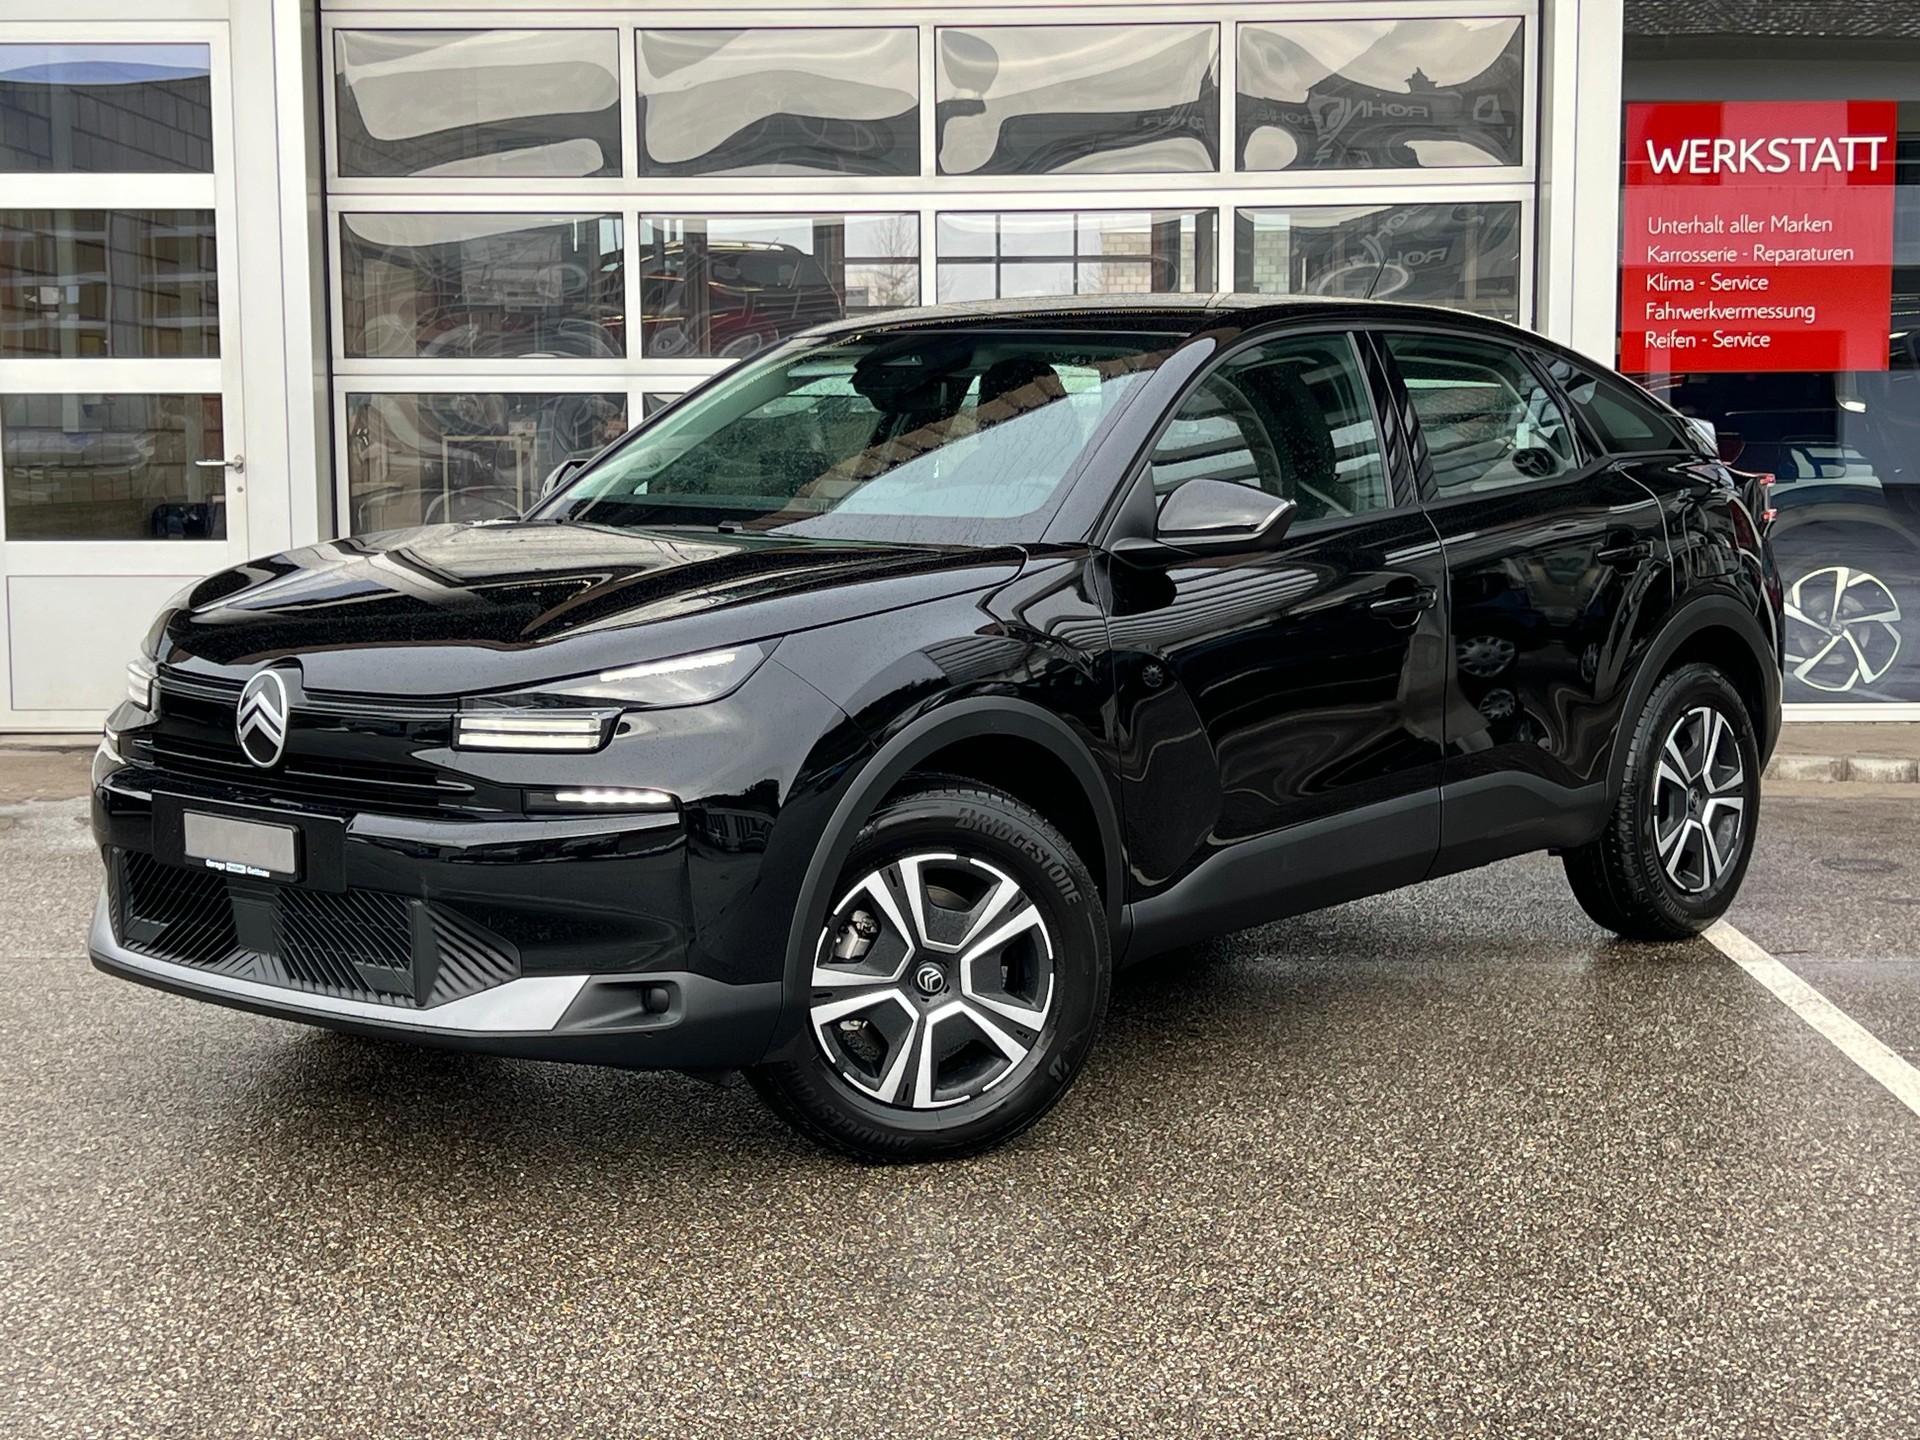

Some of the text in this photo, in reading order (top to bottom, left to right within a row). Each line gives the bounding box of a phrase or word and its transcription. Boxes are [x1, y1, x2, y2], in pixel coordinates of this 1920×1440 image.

[1646, 136, 1888, 175] WERKSTATT
[1648, 213, 1833, 235] Unterhalt aller Marken
[1647, 245, 1738, 263] Karrosserie
[1753, 243, 1854, 266] Reparaturen
[1646, 274, 1695, 292] Klima
[1710, 272, 1769, 291] Service
[1645, 301, 1816, 324] Fahrwerkvermessung
[1645, 329, 1697, 349] Reifen
[1712, 329, 1771, 349] Service
[955, 807, 1081, 906] BRIDGESTONE
